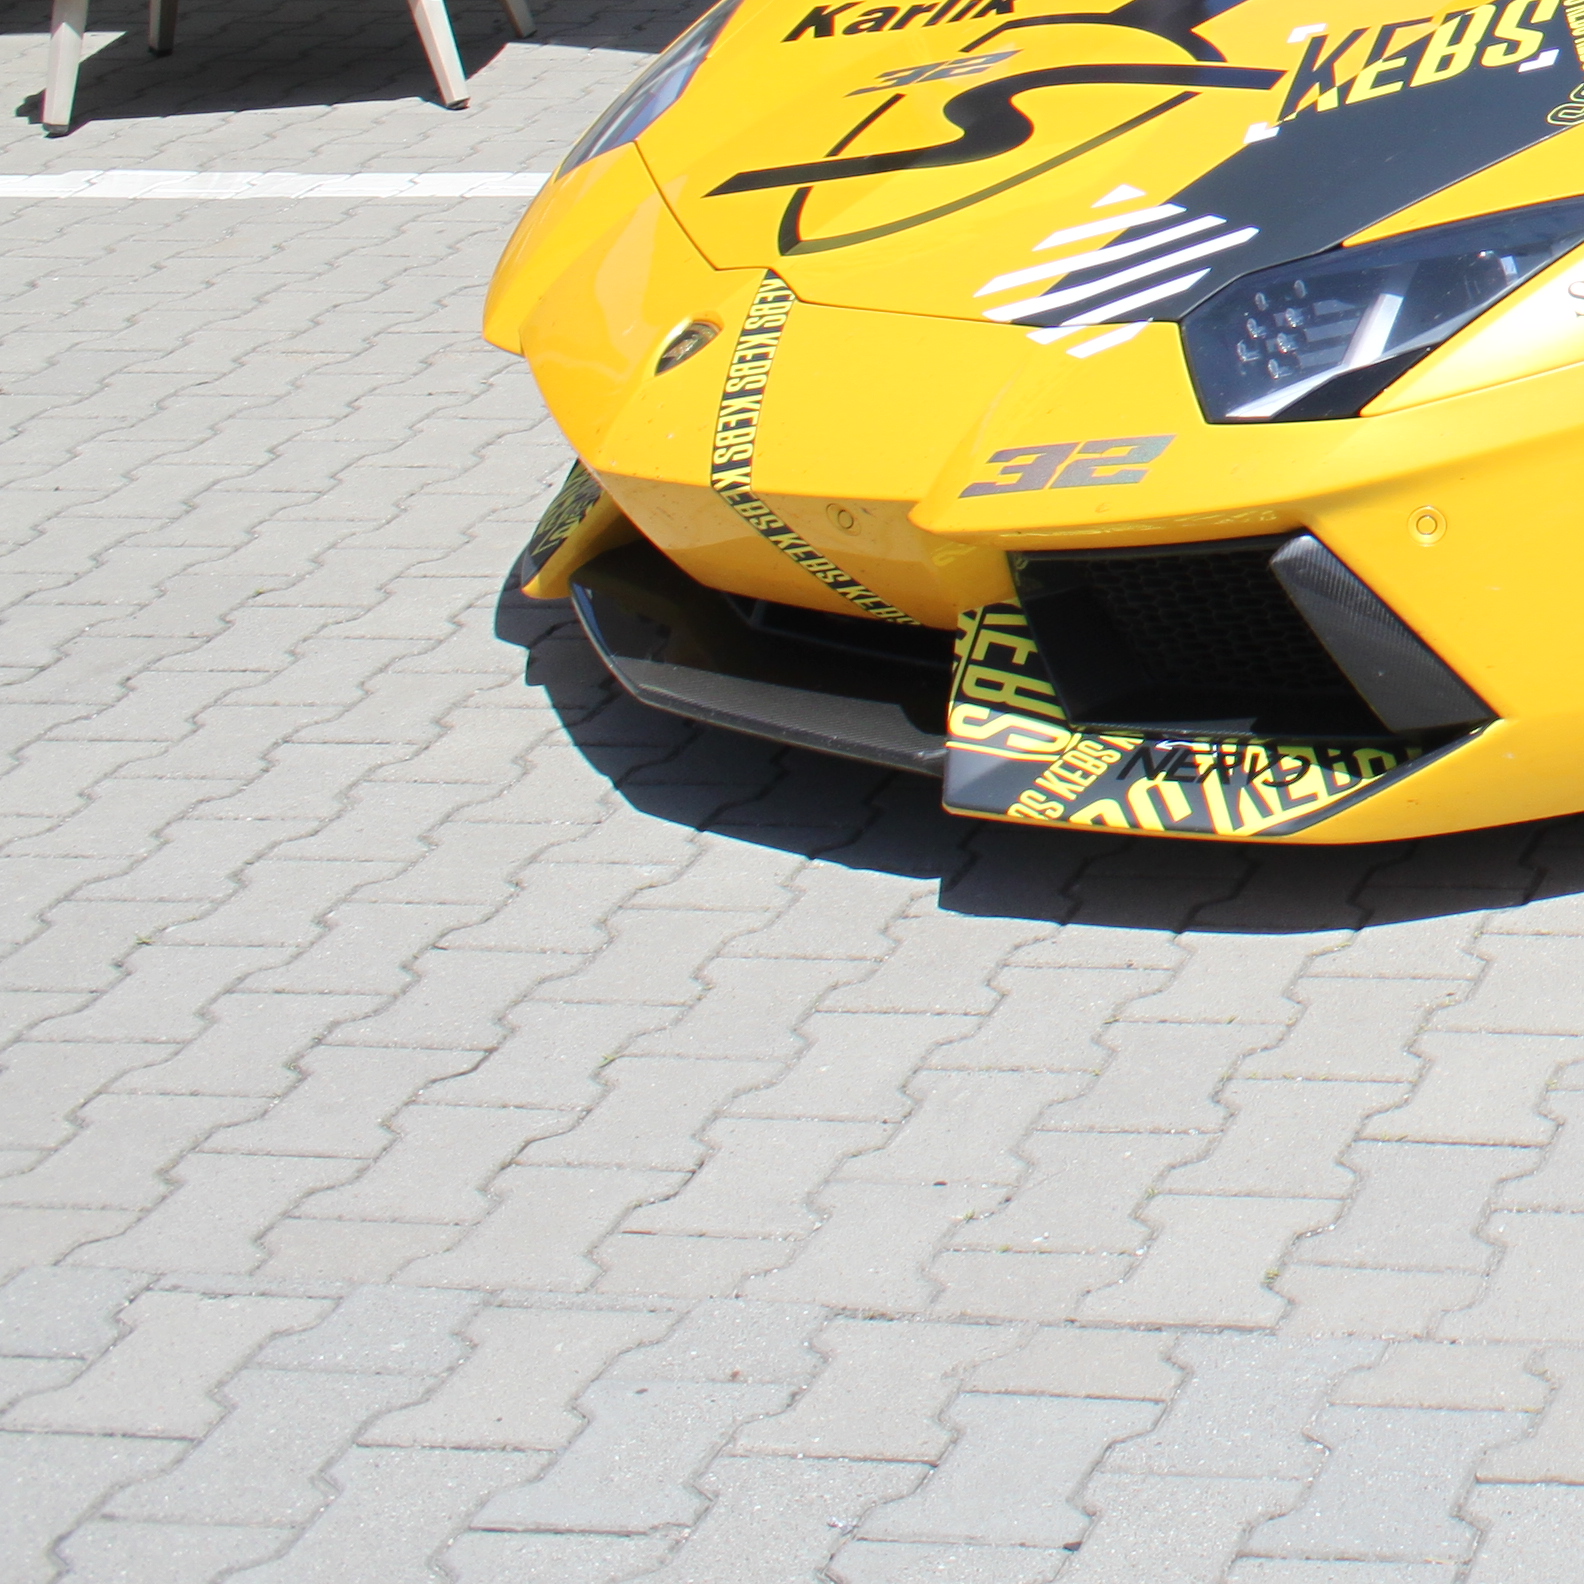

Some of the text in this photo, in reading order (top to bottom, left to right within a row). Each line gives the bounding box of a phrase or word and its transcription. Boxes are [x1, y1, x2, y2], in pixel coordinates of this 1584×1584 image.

[725, 332, 782, 393] KEBS
[712, 393, 763, 465] KEBS
[958, 434, 1178, 499] 32
[712, 466, 775, 536] KEBS
[769, 532, 844, 584] KEBS
